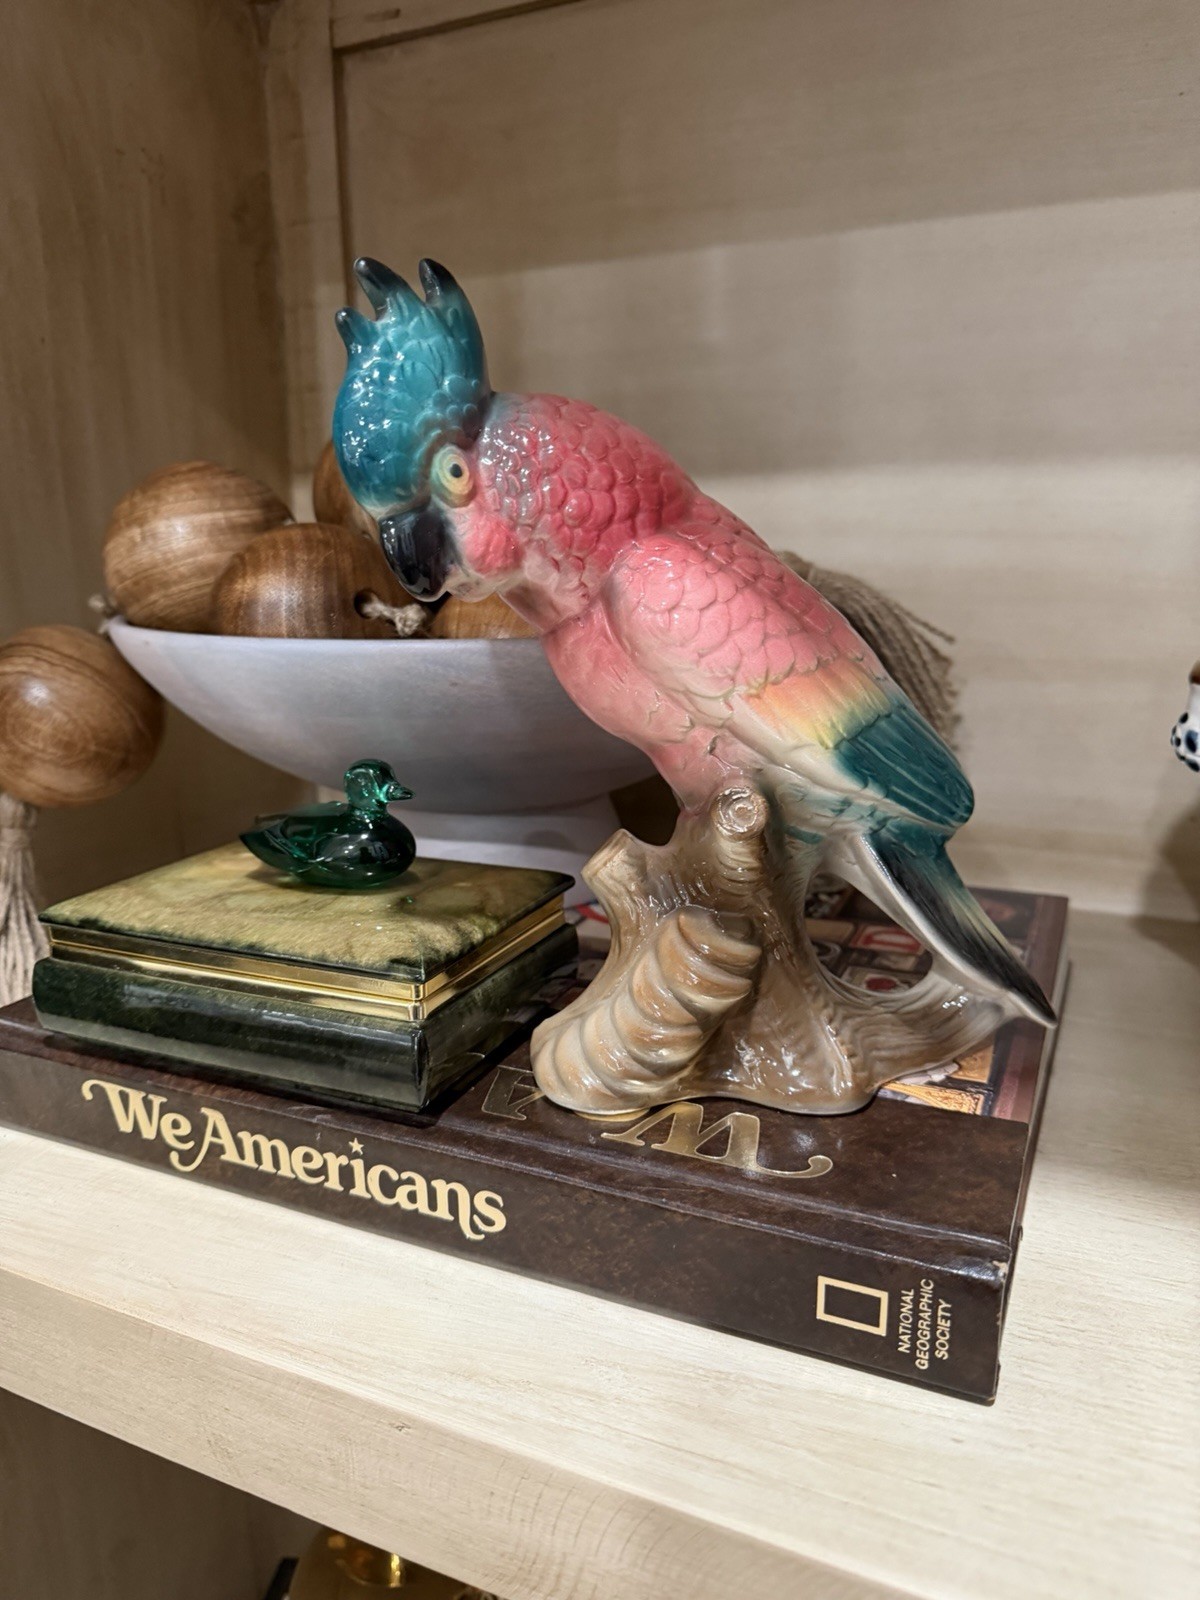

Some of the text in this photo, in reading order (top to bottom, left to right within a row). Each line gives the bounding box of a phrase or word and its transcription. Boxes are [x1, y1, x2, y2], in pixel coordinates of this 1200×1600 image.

[80, 1078, 507, 1241] We Americans
[898, 1288, 915, 1353] NATIONAL
[915, 1278, 935, 1370] GEOGRAPHIC
[935, 1299, 952, 1360] SOCIETY
